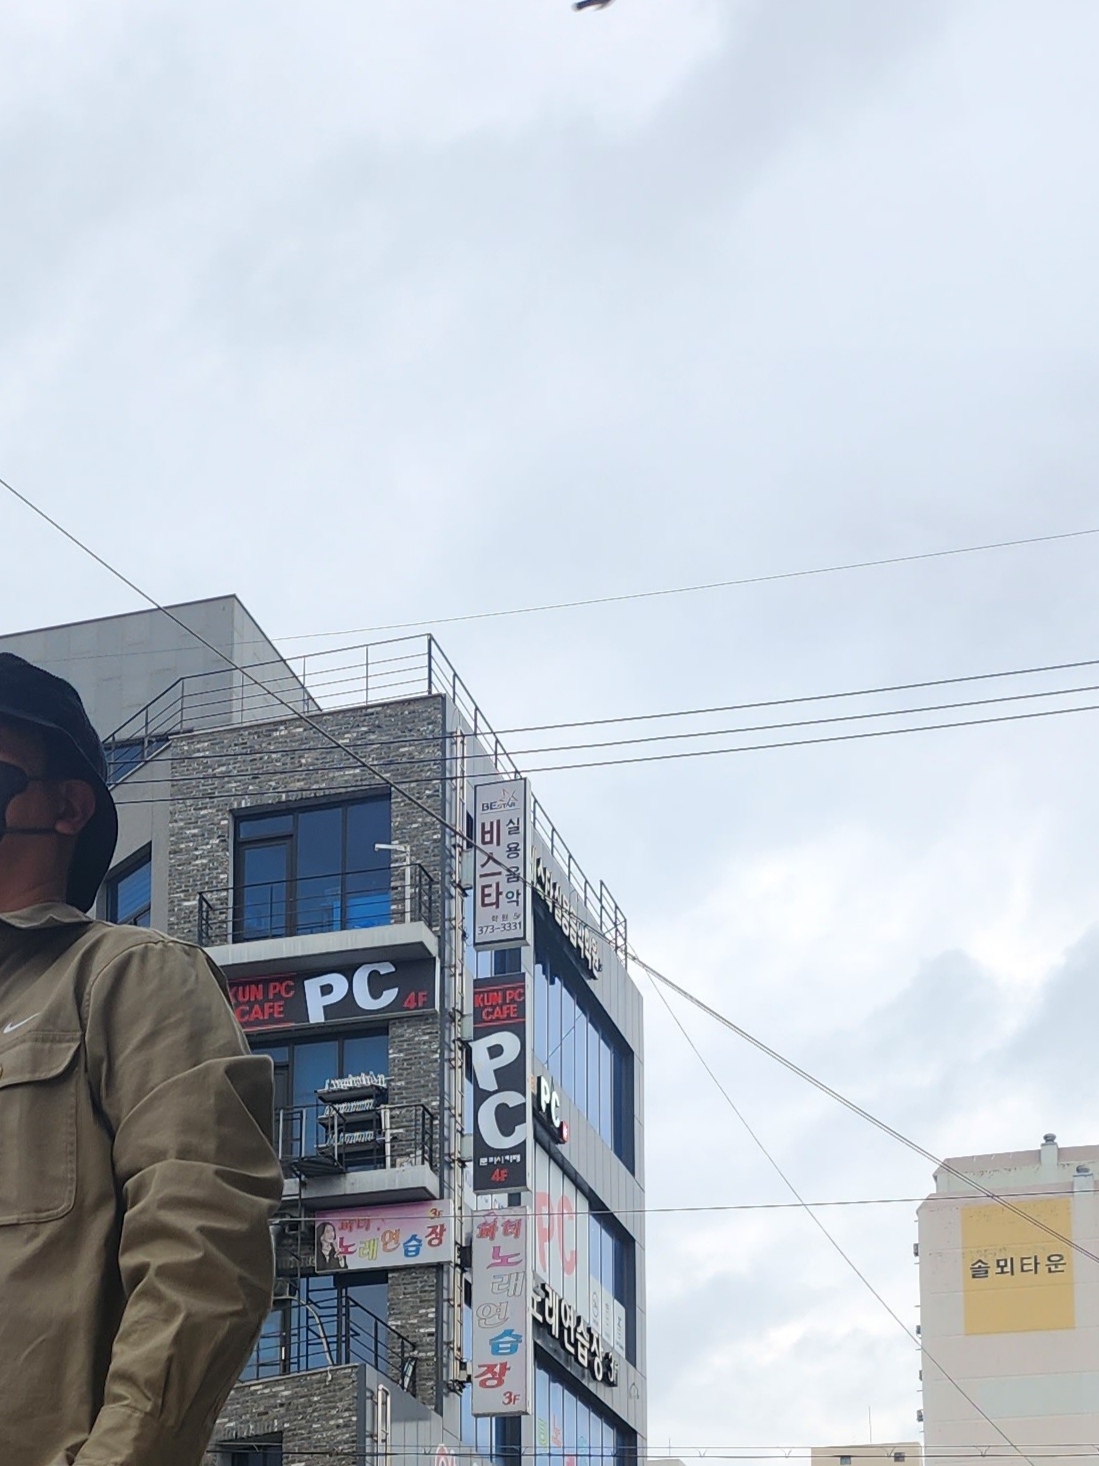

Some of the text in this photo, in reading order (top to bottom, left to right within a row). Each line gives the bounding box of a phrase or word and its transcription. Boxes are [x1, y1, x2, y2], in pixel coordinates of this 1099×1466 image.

[479, 818, 503, 910] 비스타
[505, 817, 521, 907] 실용음악
[478, 921, 522, 935] 373-3331
[268, 981, 295, 998] PC
[304, 961, 399, 1024] PC
[403, 991, 428, 1009] 4F
[474, 989, 525, 1008] KUN PC
[234, 1001, 285, 1022] CAFE
[481, 1004, 518, 1021] CAFE
[468, 1031, 527, 1150] PC
[540, 1075, 561, 1128] PC
[337, 1223, 447, 1261] 노래연습장
[535, 1191, 578, 1276] PC
[969, 1253, 1067, 1279] 솔뫼타운
[474, 1246, 525, 1389] 노래연습장
[502, 1391, 521, 1406] 3F
